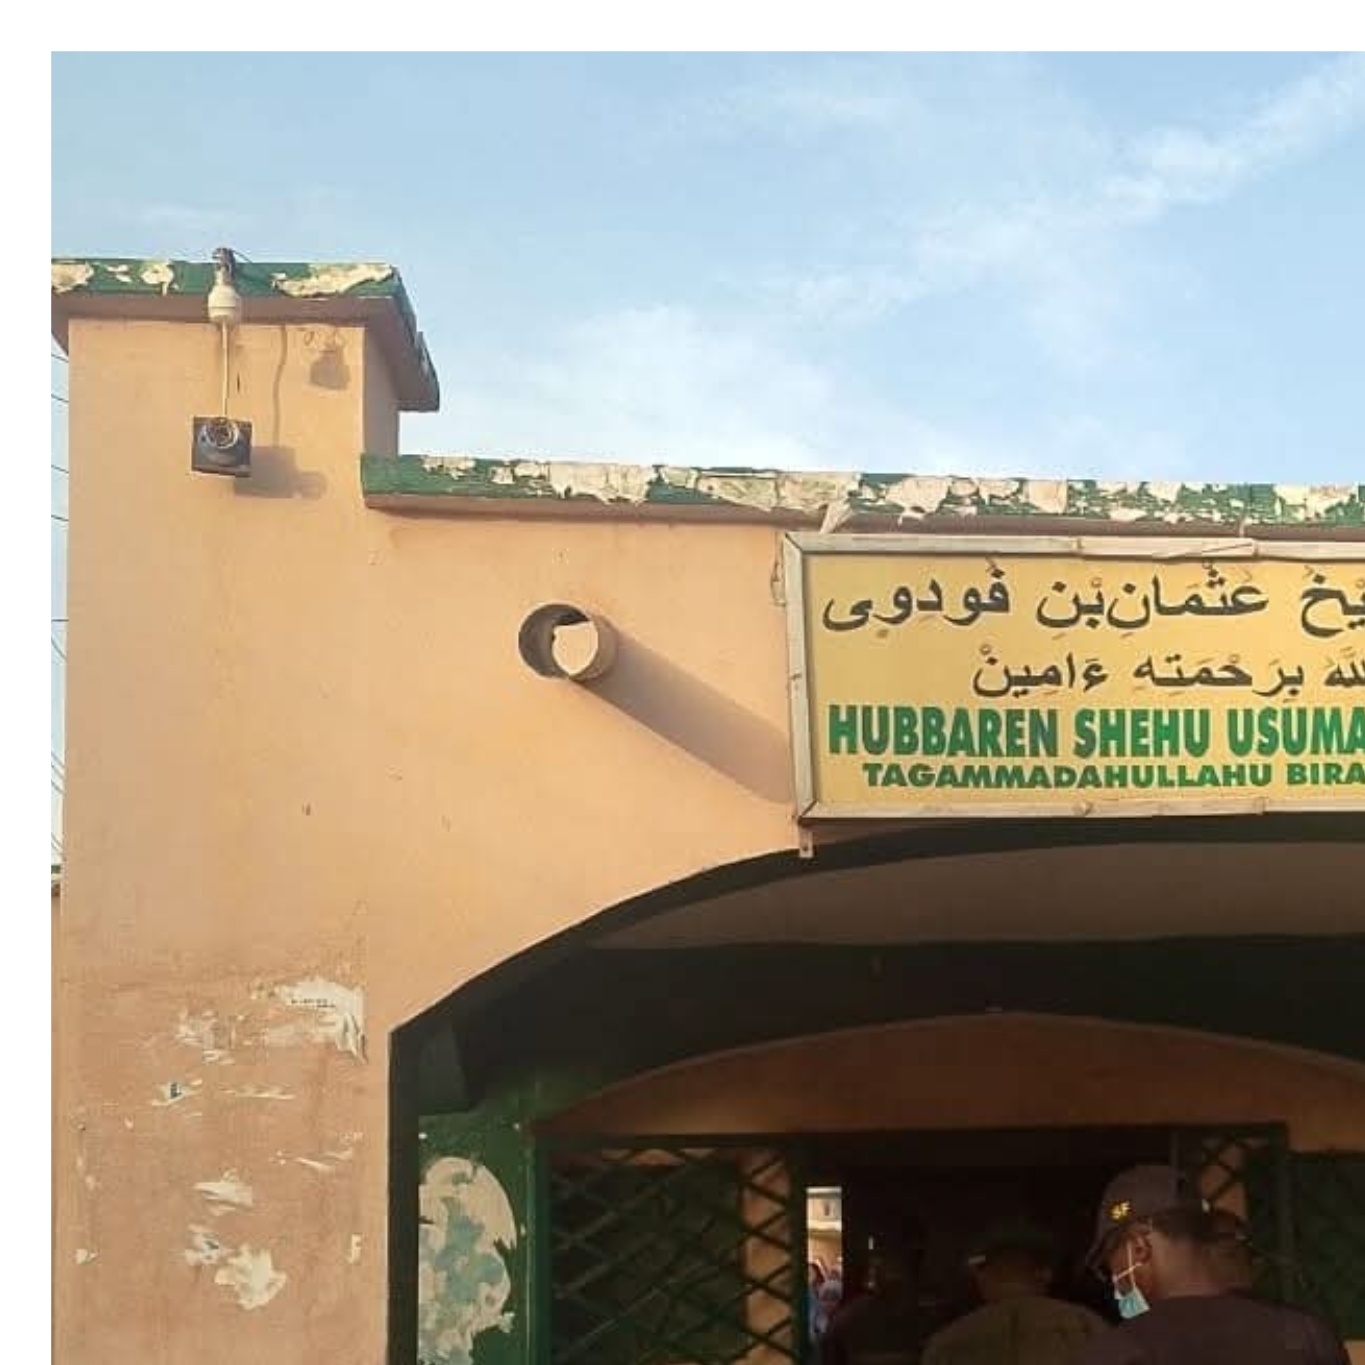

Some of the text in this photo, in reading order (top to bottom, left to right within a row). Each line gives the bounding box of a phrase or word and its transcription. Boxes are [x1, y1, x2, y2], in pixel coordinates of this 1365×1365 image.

[828, 704, 1059, 758] HUBBAREN
[1073, 707, 1211, 759] SHEHU
[862, 762, 1271, 788] TAGAMMADAHULLAHU
